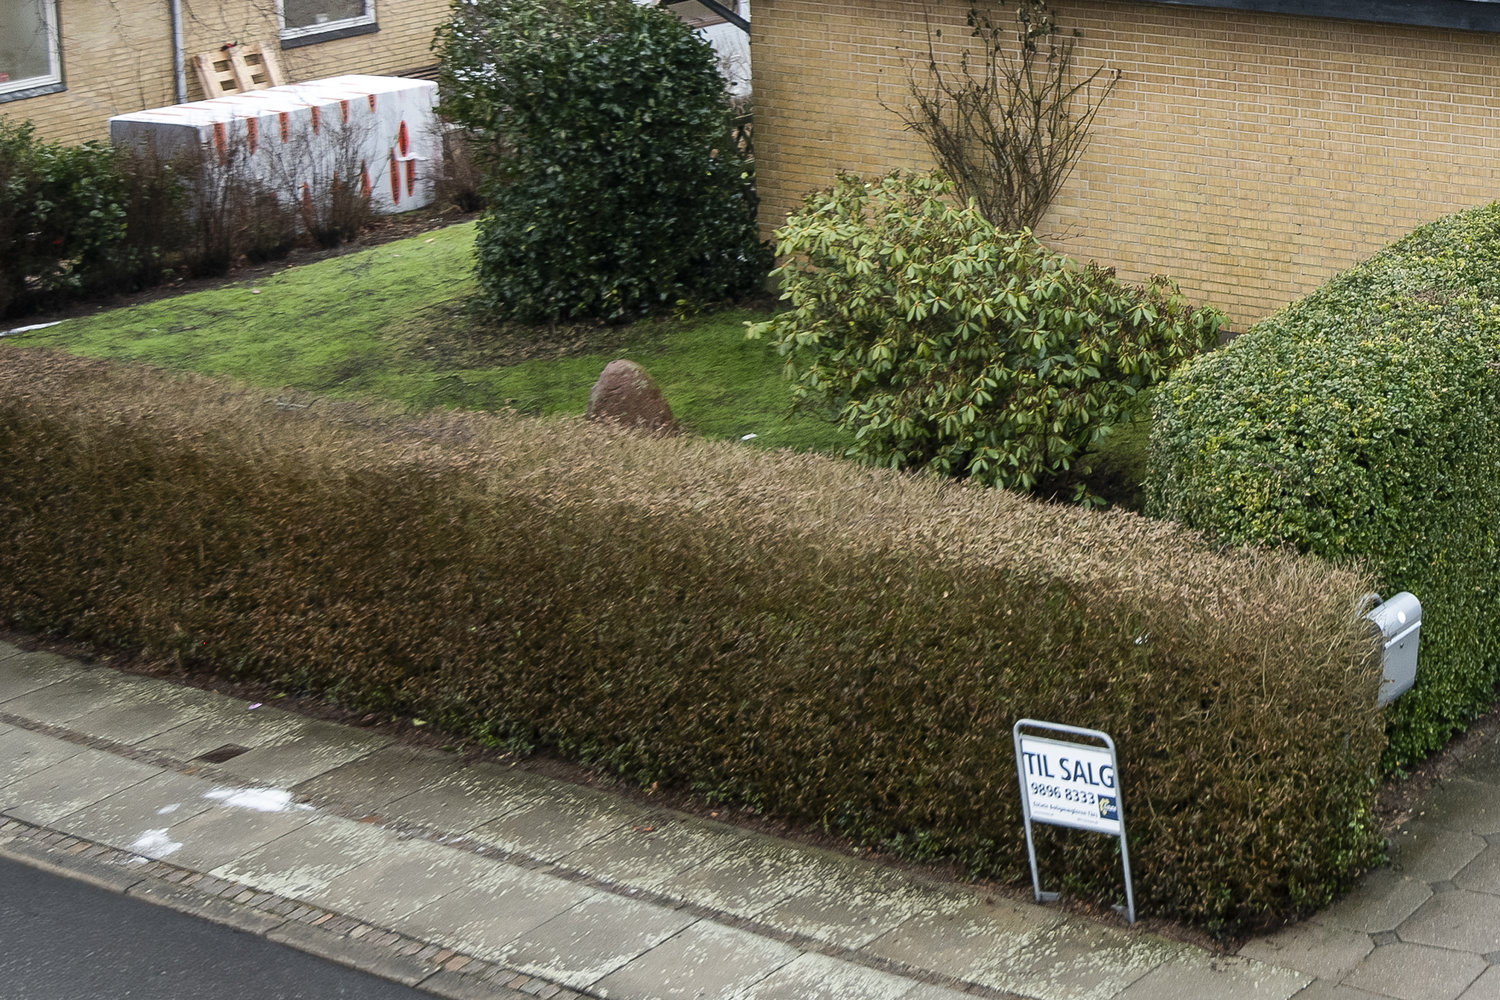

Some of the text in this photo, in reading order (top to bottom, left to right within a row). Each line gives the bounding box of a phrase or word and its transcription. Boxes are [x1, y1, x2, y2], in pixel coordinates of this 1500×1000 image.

[1023, 751, 1115, 788] TIL SALG
[1031, 782, 1095, 805] 9896 8333
